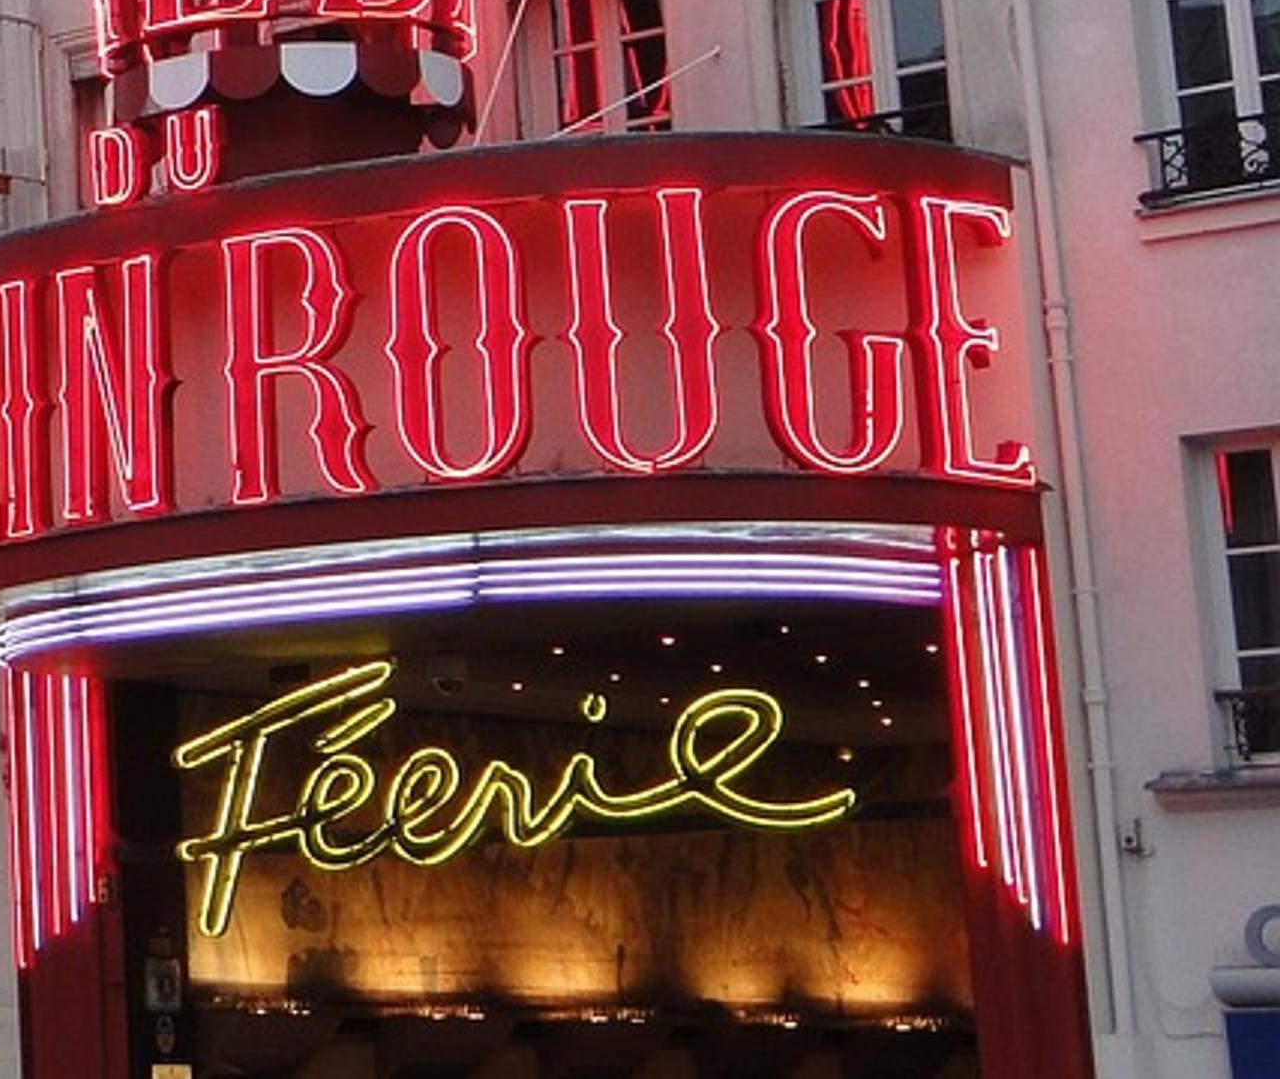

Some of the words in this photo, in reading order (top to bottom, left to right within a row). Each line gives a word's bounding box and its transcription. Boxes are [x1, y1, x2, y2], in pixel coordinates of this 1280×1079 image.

[90, 109, 218, 206] DU
[219, 186, 1038, 506] ROUGE
[175, 660, 857, 937] Féerie
